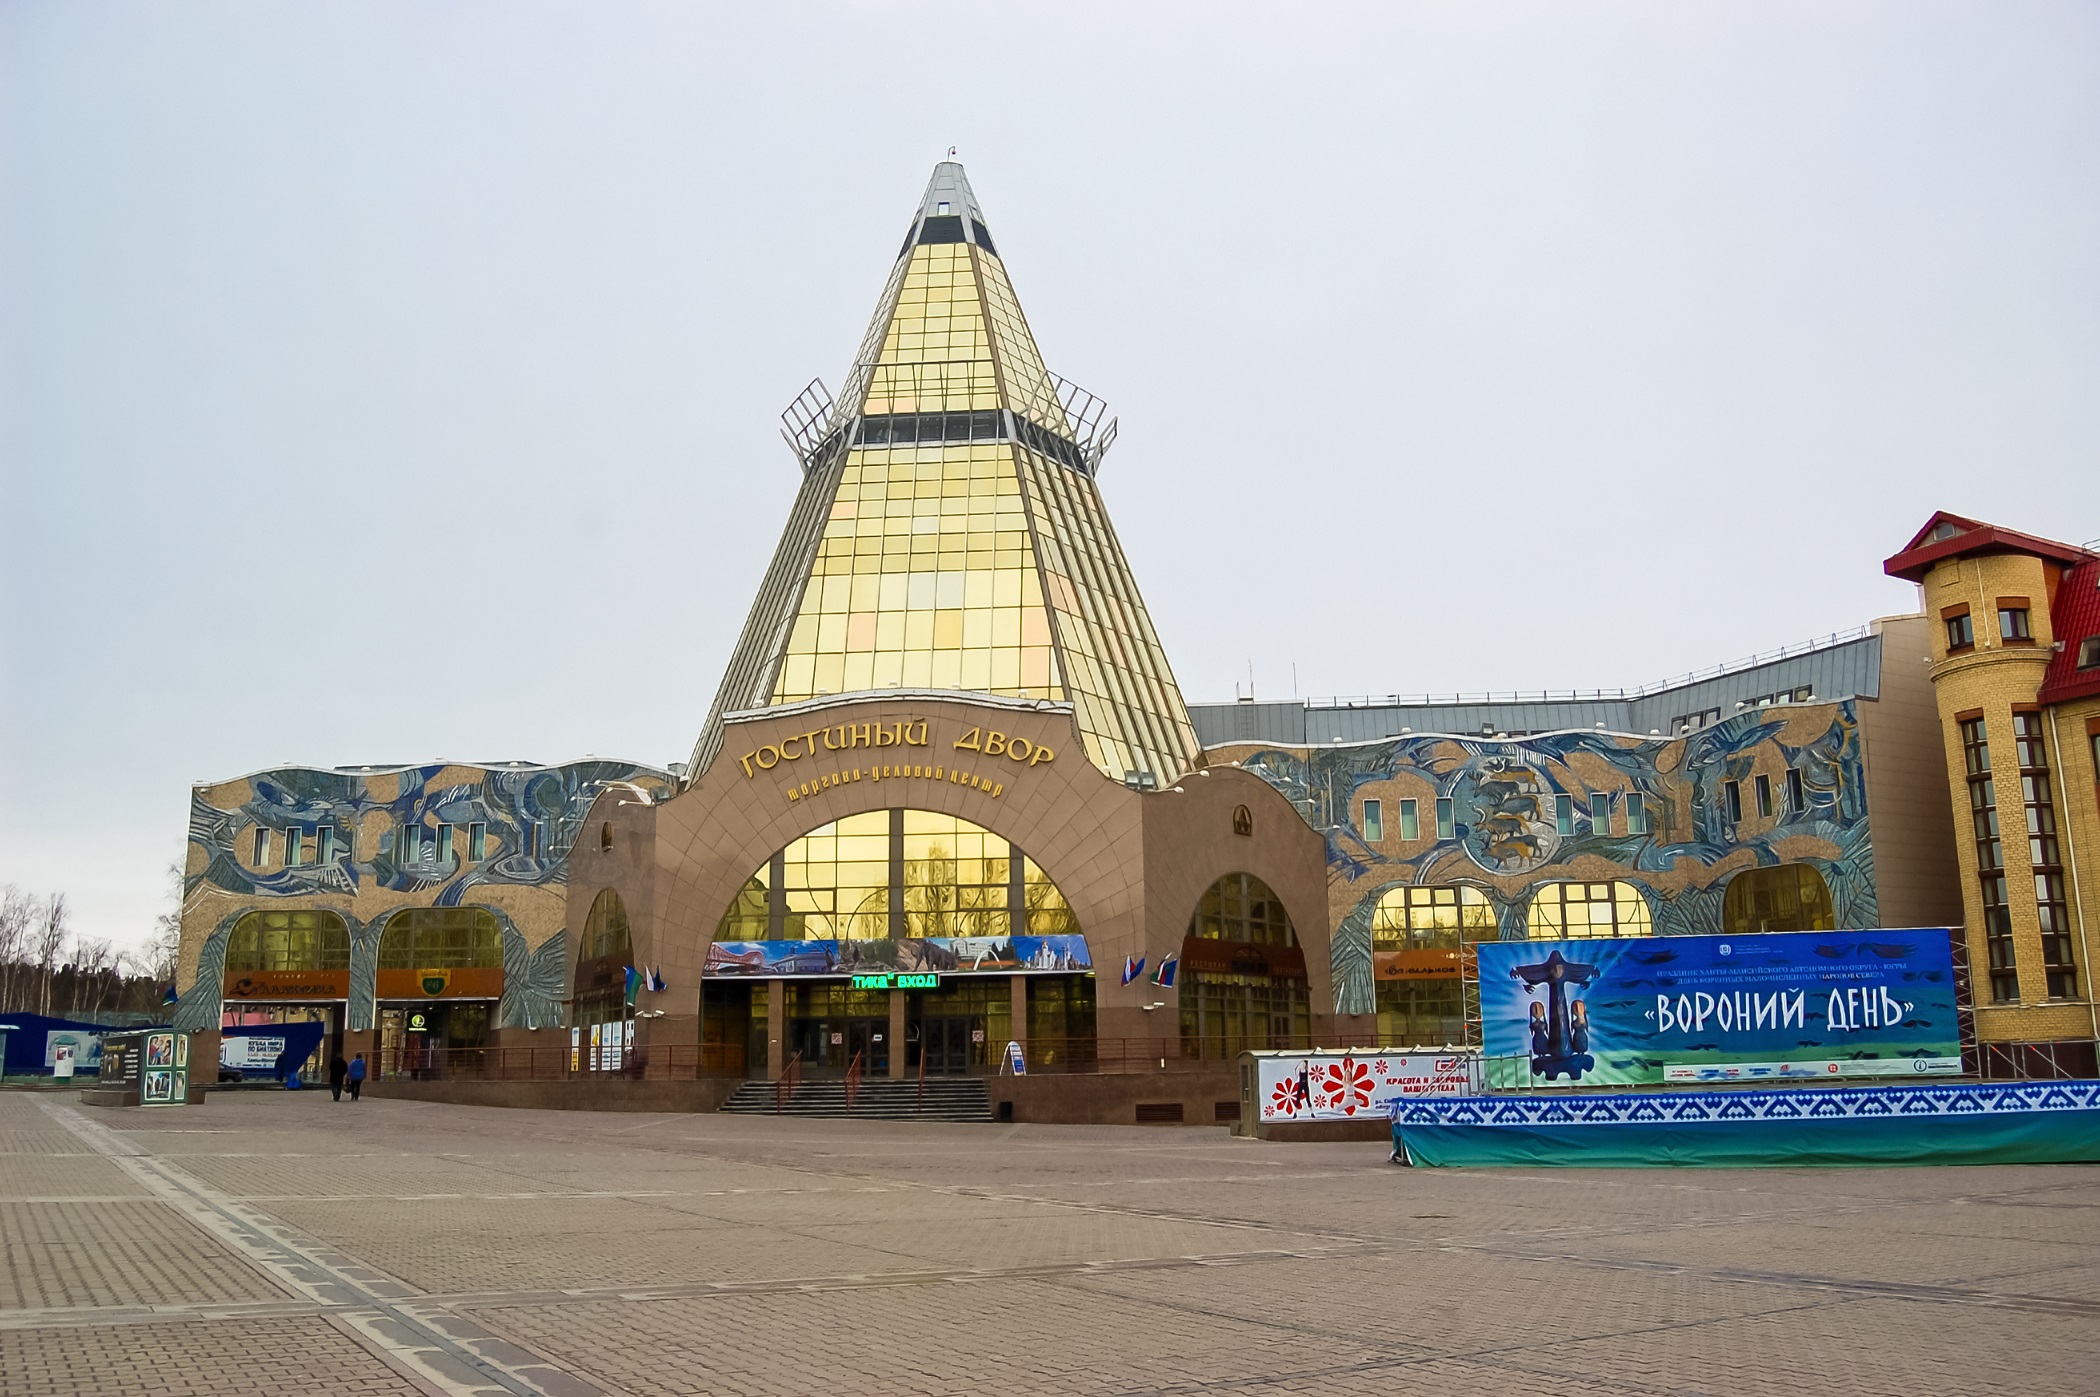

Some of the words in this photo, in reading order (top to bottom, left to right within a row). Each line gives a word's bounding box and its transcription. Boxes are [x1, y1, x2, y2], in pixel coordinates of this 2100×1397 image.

[739, 716, 929, 779] ГОСТИНЫЙ
[953, 727, 1055, 767] ДВОР
[787, 765, 944, 801] торгово-деловой
[950, 769, 1004, 798] центр
[1644, 987, 1805, 1034] «ВОРОНИЙ
[1827, 986, 1914, 1032] ДЕНЬ»
[1386, 1077, 1421, 1085] КРАСОТА
